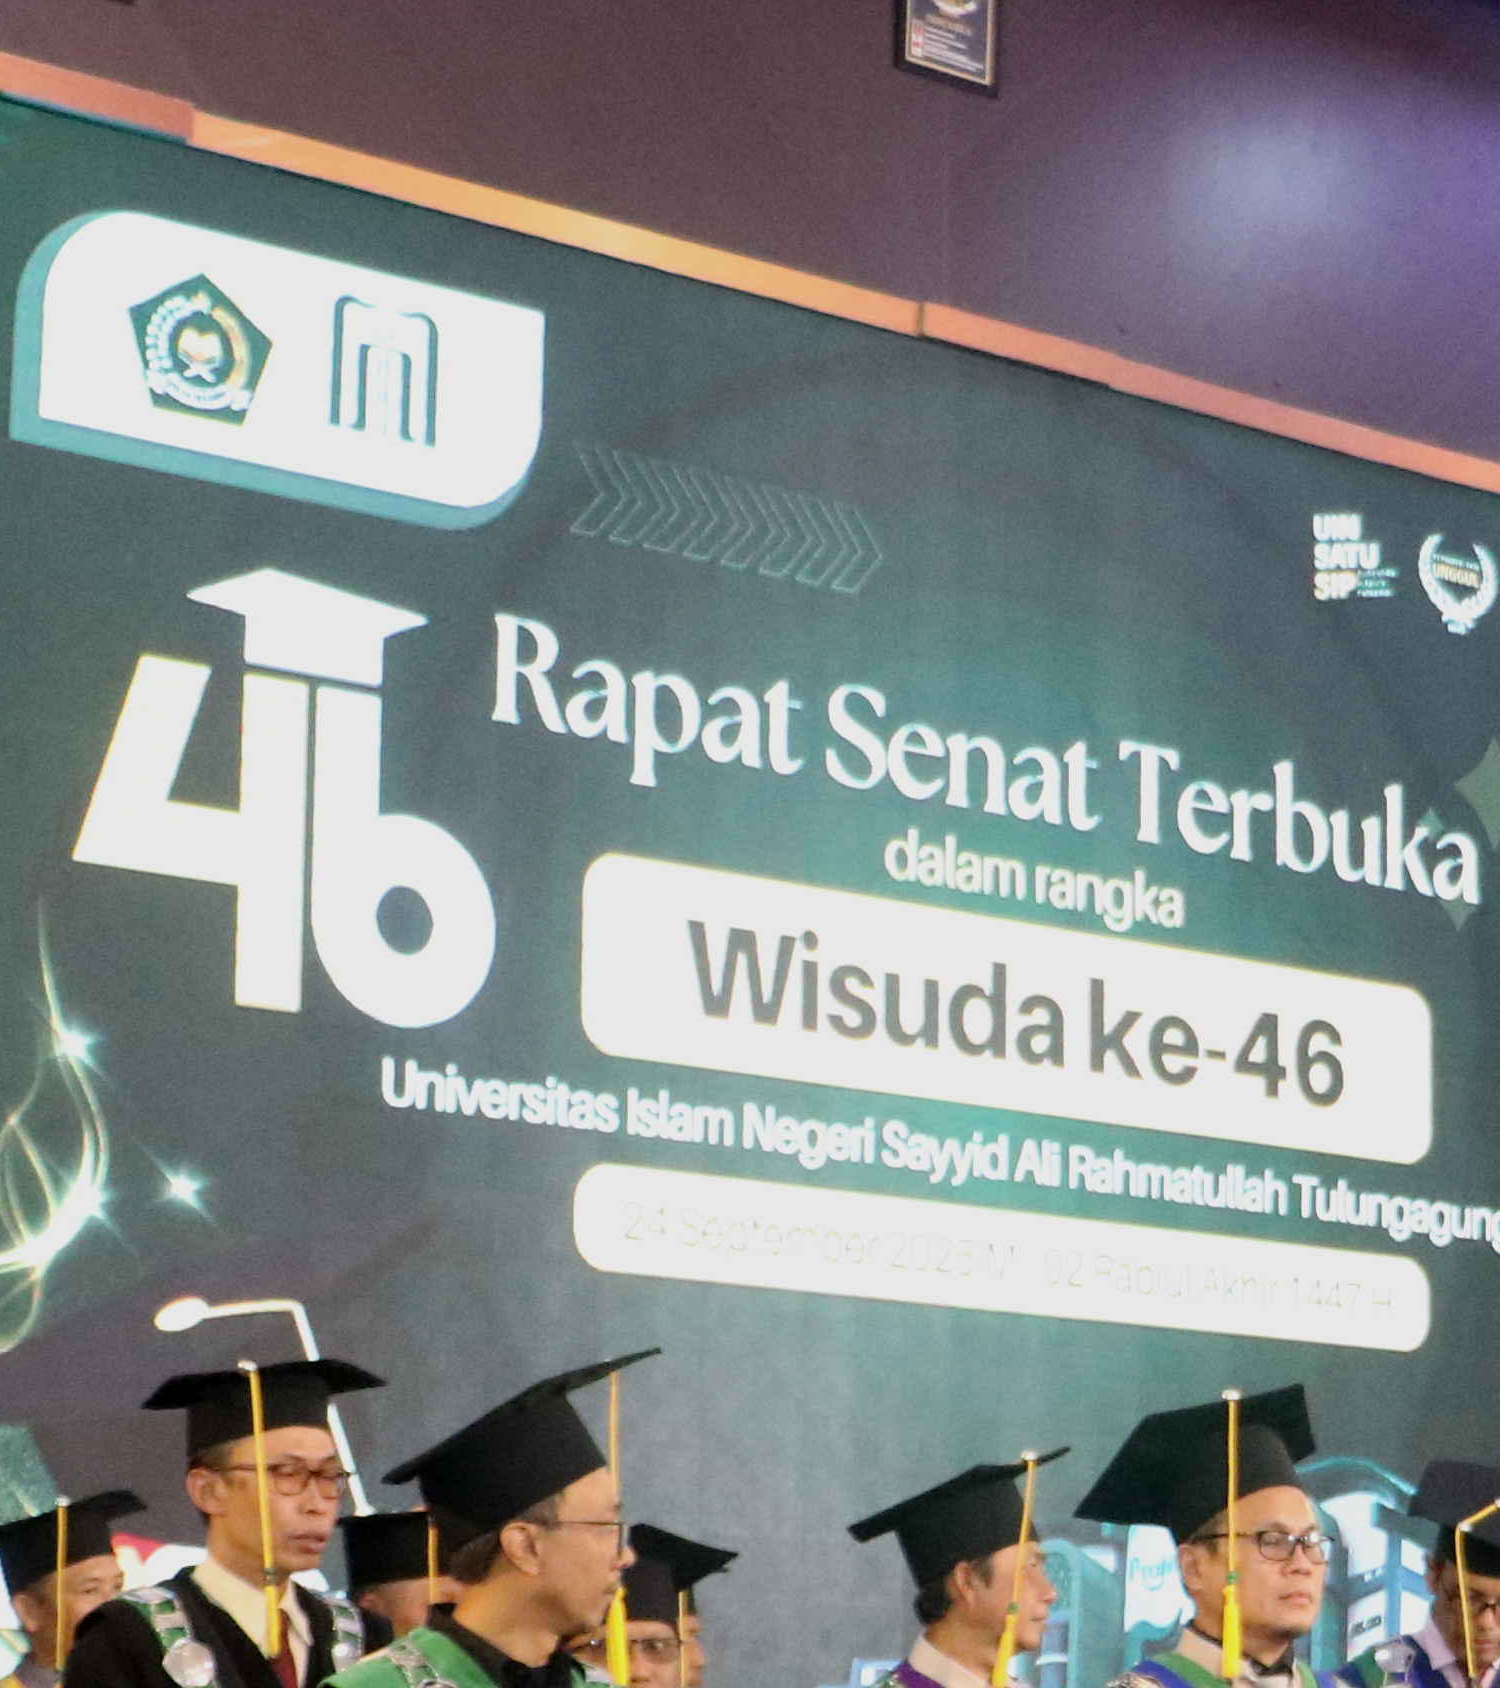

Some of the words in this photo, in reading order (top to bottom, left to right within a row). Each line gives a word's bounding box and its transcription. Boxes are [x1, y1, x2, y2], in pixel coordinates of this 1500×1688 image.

[1314, 541, 1380, 570] SATU
[1314, 570, 1358, 601] SIP
[492, 613, 804, 787] Rapat
[825, 683, 1101, 833] Senat
[1118, 739, 1481, 905] Terbuka
[72, 653, 497, 1029] 46
[884, 827, 1026, 900] dalam
[1033, 863, 1186, 933] rangka
[687, 920, 1066, 1069] Wisuda
[1089, 977, 1346, 1108] ke-46
[380, 1055, 620, 1134] Universitas
[626, 1087, 735, 1147] Islam
[742, 1101, 875, 1170] Negeri
[880, 1116, 1008, 1186] Sayyid
[1014, 1137, 1062, 1188] Ali
[1067, 1144, 1289, 1216] Rahmatullah
[621, 1200, 667, 1242] 24
